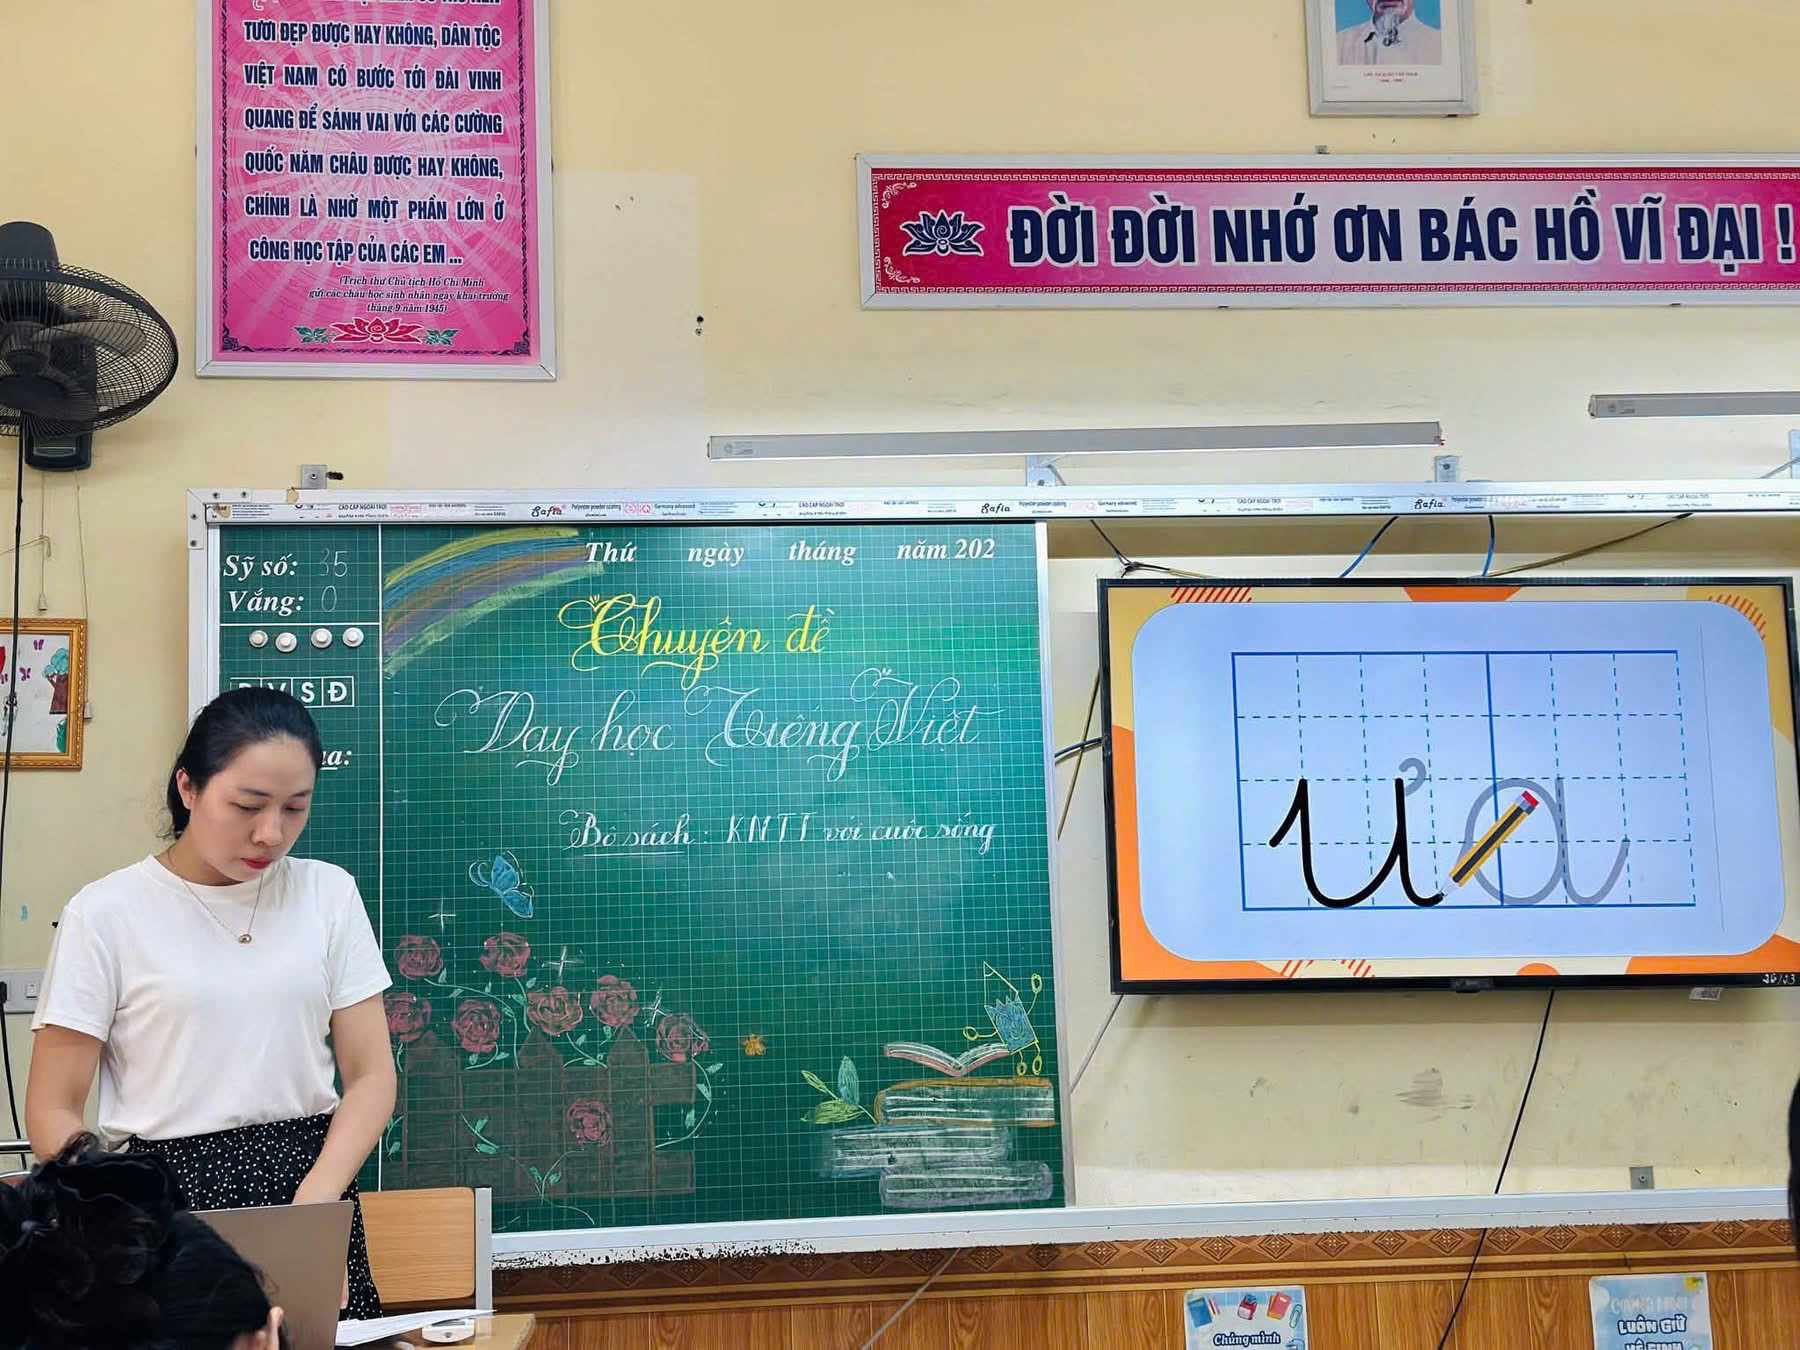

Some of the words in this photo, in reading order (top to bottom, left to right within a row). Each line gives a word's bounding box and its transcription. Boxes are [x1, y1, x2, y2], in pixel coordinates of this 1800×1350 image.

[244, 21, 275, 41] TƯƠI
[280, 23, 307, 45] ĐẸP
[312, 23, 349, 48] ĐƯỢC
[355, 25, 381, 44] HAY
[385, 23, 437, 48] KHÔNG,
[442, 23, 470, 46] DÂN
[474, 23, 501, 50] TỘC
[245, 65, 274, 88] VIỆT
[284, 66, 318, 86] NAM
[328, 64, 346, 87] CÓ
[357, 64, 394, 88] BƯỚC
[404, 64, 425, 89] TỚI
[436, 68, 458, 89] ĐÀI
[469, 71, 501, 90] VINH
[245, 109, 293, 129] QUANG
[299, 103, 318, 129] ĐỂ
[323, 108, 361, 131] SÁNH
[366, 112, 389, 131] VAI
[394, 109, 416, 132] VỚI
[422, 110, 450, 133] CÁC
[455, 111, 502, 134] CƯỜNG
[246, 145, 283, 174] QUỐC
[290, 151, 323, 173] NĂM
[330, 152, 368, 175] CHÂU
[374, 154, 411, 181] ĐƯỢC
[418, 157, 444, 176] HAY
[451, 154, 503, 180] KHÔNG,
[246, 195, 289, 217] CHÍNH
[300, 196, 317, 217] LÀ
[327, 196, 358, 218] NHỜ
[368, 198, 398, 223] MỘT
[409, 195, 447, 220] PHẦN
[457, 196, 484, 220] LỚN
[494, 192, 504, 220] Ở
[1010, 194, 1095, 263] ĐỜI
[1111, 194, 1195, 263] ĐỜI
[1212, 192, 1318, 263] NHỚ
[1334, 204, 1402, 263] ƠN
[1419, 196, 1518, 262] BÁC
[1535, 188, 1599, 261] HỒ
[1615, 196, 1663, 261] VĨ
[1677, 207, 1759, 272] ĐẠI
[1777, 207, 1793, 260] !
[250, 236, 289, 260] CÔNG
[294, 241, 322, 265] HỌC
[326, 237, 353, 265] TẬP
[358, 235, 387, 263] CỦA
[391, 239, 419, 263] CÁC
[423, 244, 445, 263] EM
[326, 288, 340, 298] các
[368, 289, 383, 300] học
[386, 290, 405, 299] sinh
[370, 277, 385, 286] thư
[408, 278, 425, 288] tịch
[462, 278, 484, 287] Minh
[367, 303, 393, 313] tháng
[395, 304, 400, 312] 9
[425, 304, 446, 313] 1945)
[223, 555, 255, 580] Sỹ
[262, 553, 298, 576] số:
[319, 548, 349, 577] 35
[585, 541, 638, 563] Thứ
[687, 543, 744, 567] ngày
[788, 541, 856, 565] tháng
[897, 543, 947, 560] năm
[955, 538, 996, 560] 202
[228, 587, 304, 616] Vắng:
[559, 594, 769, 690] Chuyên
[785, 604, 835, 654] đề
[301, 682, 315, 703] S
[328, 682, 347, 702] Đ
[591, 689, 673, 757] học
[684, 685, 861, 782] Tiếng
[850, 668, 1006, 752] Việt
[935, 812, 997, 855] sống
[1214, 1332, 1250, 1347] Chúng
[1251, 1331, 1281, 1345] mình
[1618, 1314, 1657, 1335] LUÔN
[1660, 1314, 1687, 1335] GIỮ
